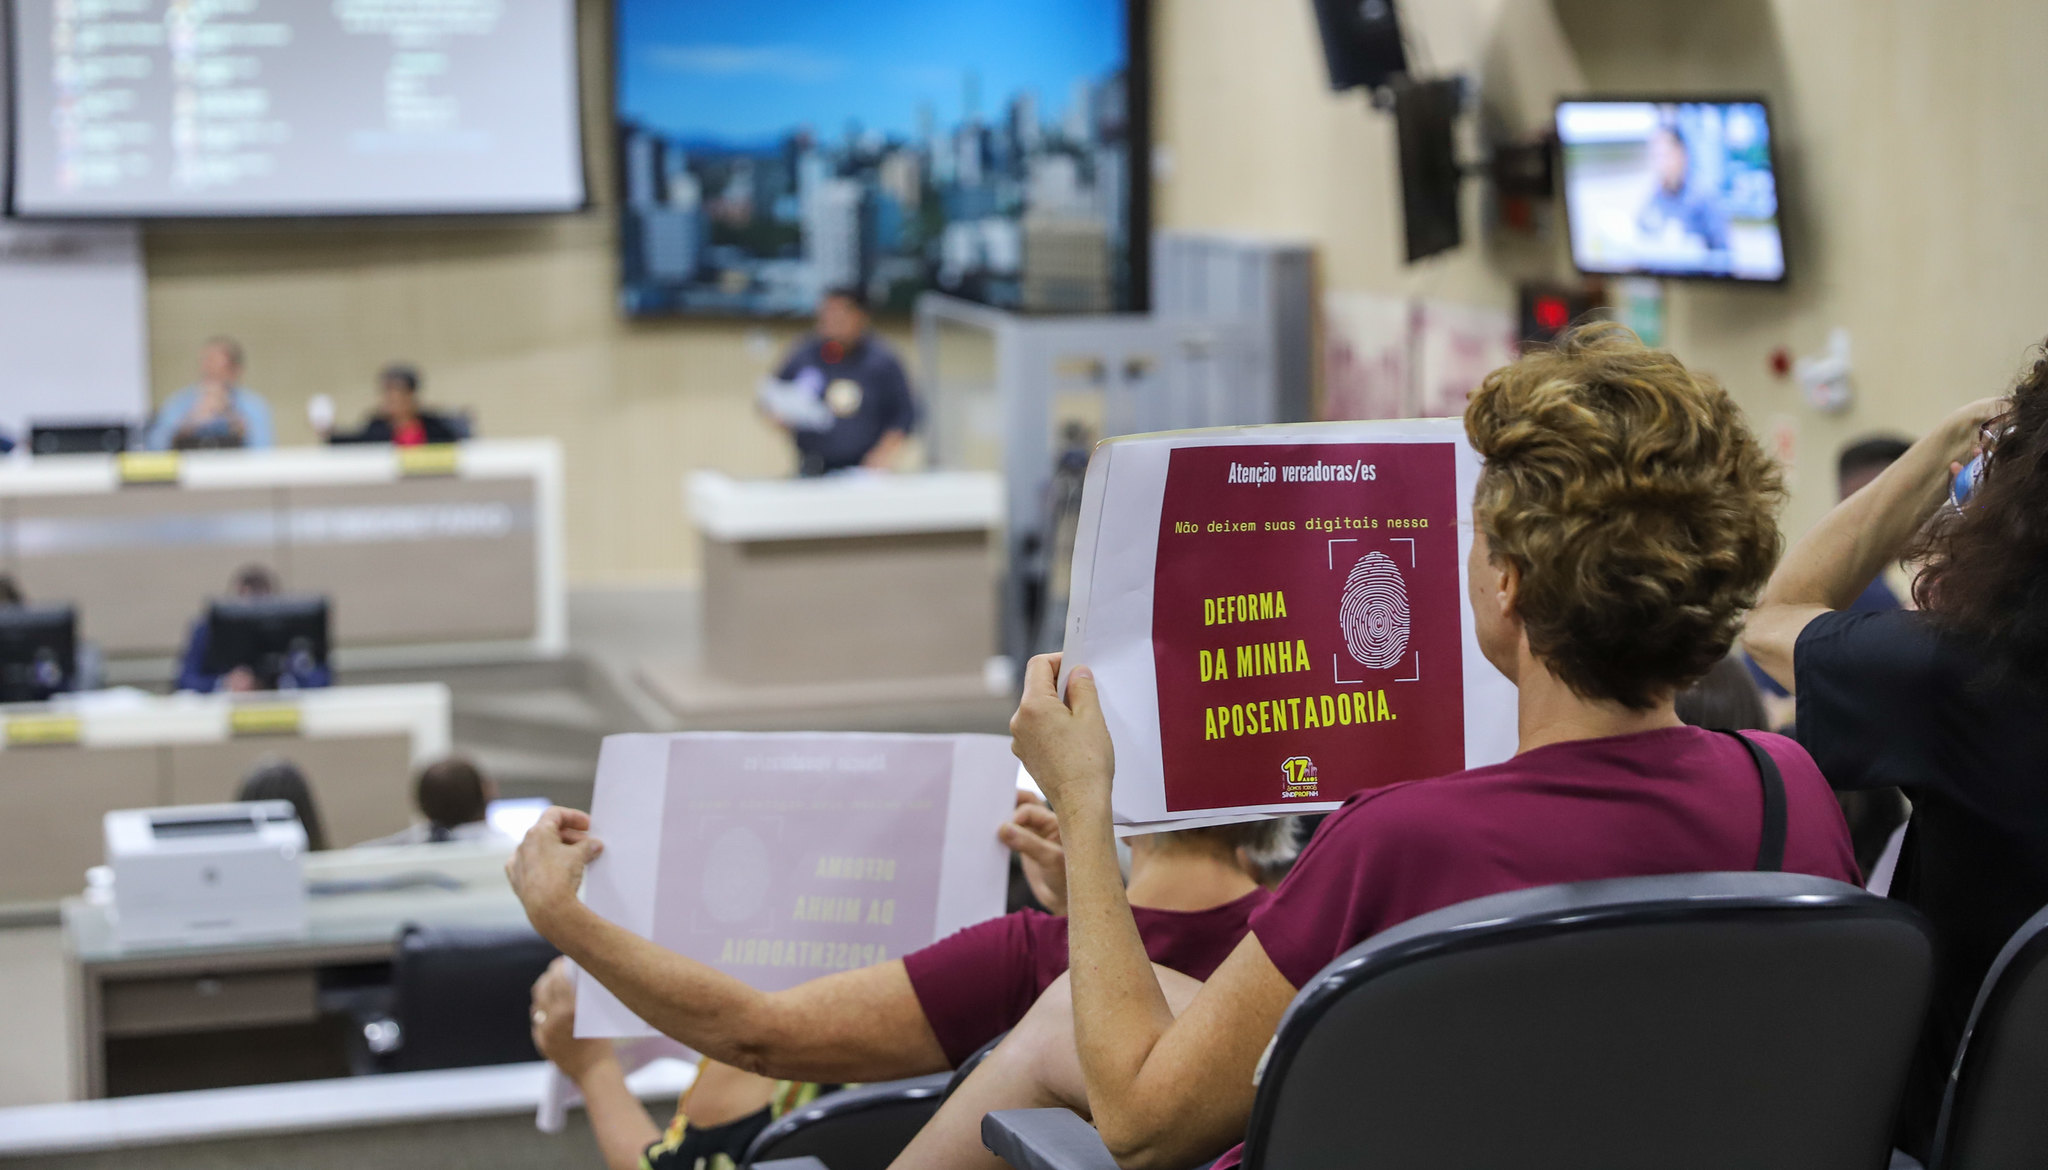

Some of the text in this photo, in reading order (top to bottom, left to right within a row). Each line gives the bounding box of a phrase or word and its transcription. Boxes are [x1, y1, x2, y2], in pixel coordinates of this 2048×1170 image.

[1228, 460, 1376, 488] Atenção vereadoras/es
[1175, 517, 1428, 534] Não deixem suas digitais nessa
[1204, 591, 1287, 626] DEFORMA
[1199, 639, 1310, 682] DA MINHA
[1205, 689, 1397, 740] APOSENTADORIA.
[1284, 760, 1308, 781] 17
